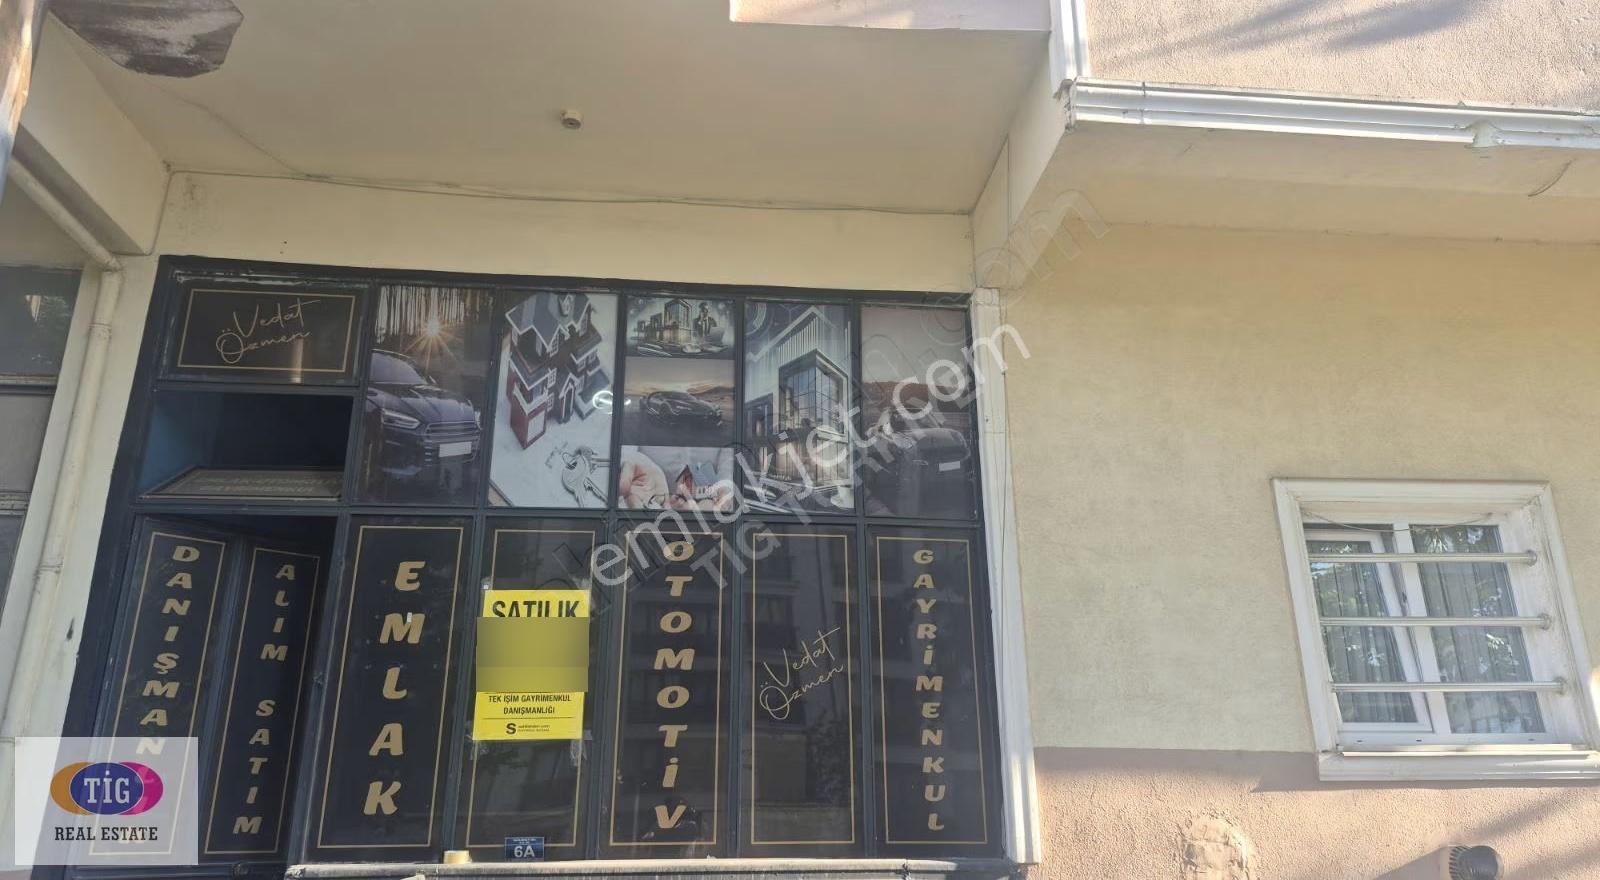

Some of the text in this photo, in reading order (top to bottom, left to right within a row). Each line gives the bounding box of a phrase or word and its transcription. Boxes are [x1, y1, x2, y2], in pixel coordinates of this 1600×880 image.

[215, 328, 311, 364] Özmen
[233, 297, 320, 338] Vedat
[653, 540, 696, 829] OTOMOTİV
[763, 626, 840, 687] Vedat
[232, 563, 296, 834] ALIM SATIM
[363, 560, 426, 816] EMLAK
[489, 695, 502, 703] TEK
[759, 664, 843, 720] Özmen
[912, 549, 946, 831] GAYRİMENKUL
[513, 845, 536, 858] 6A
